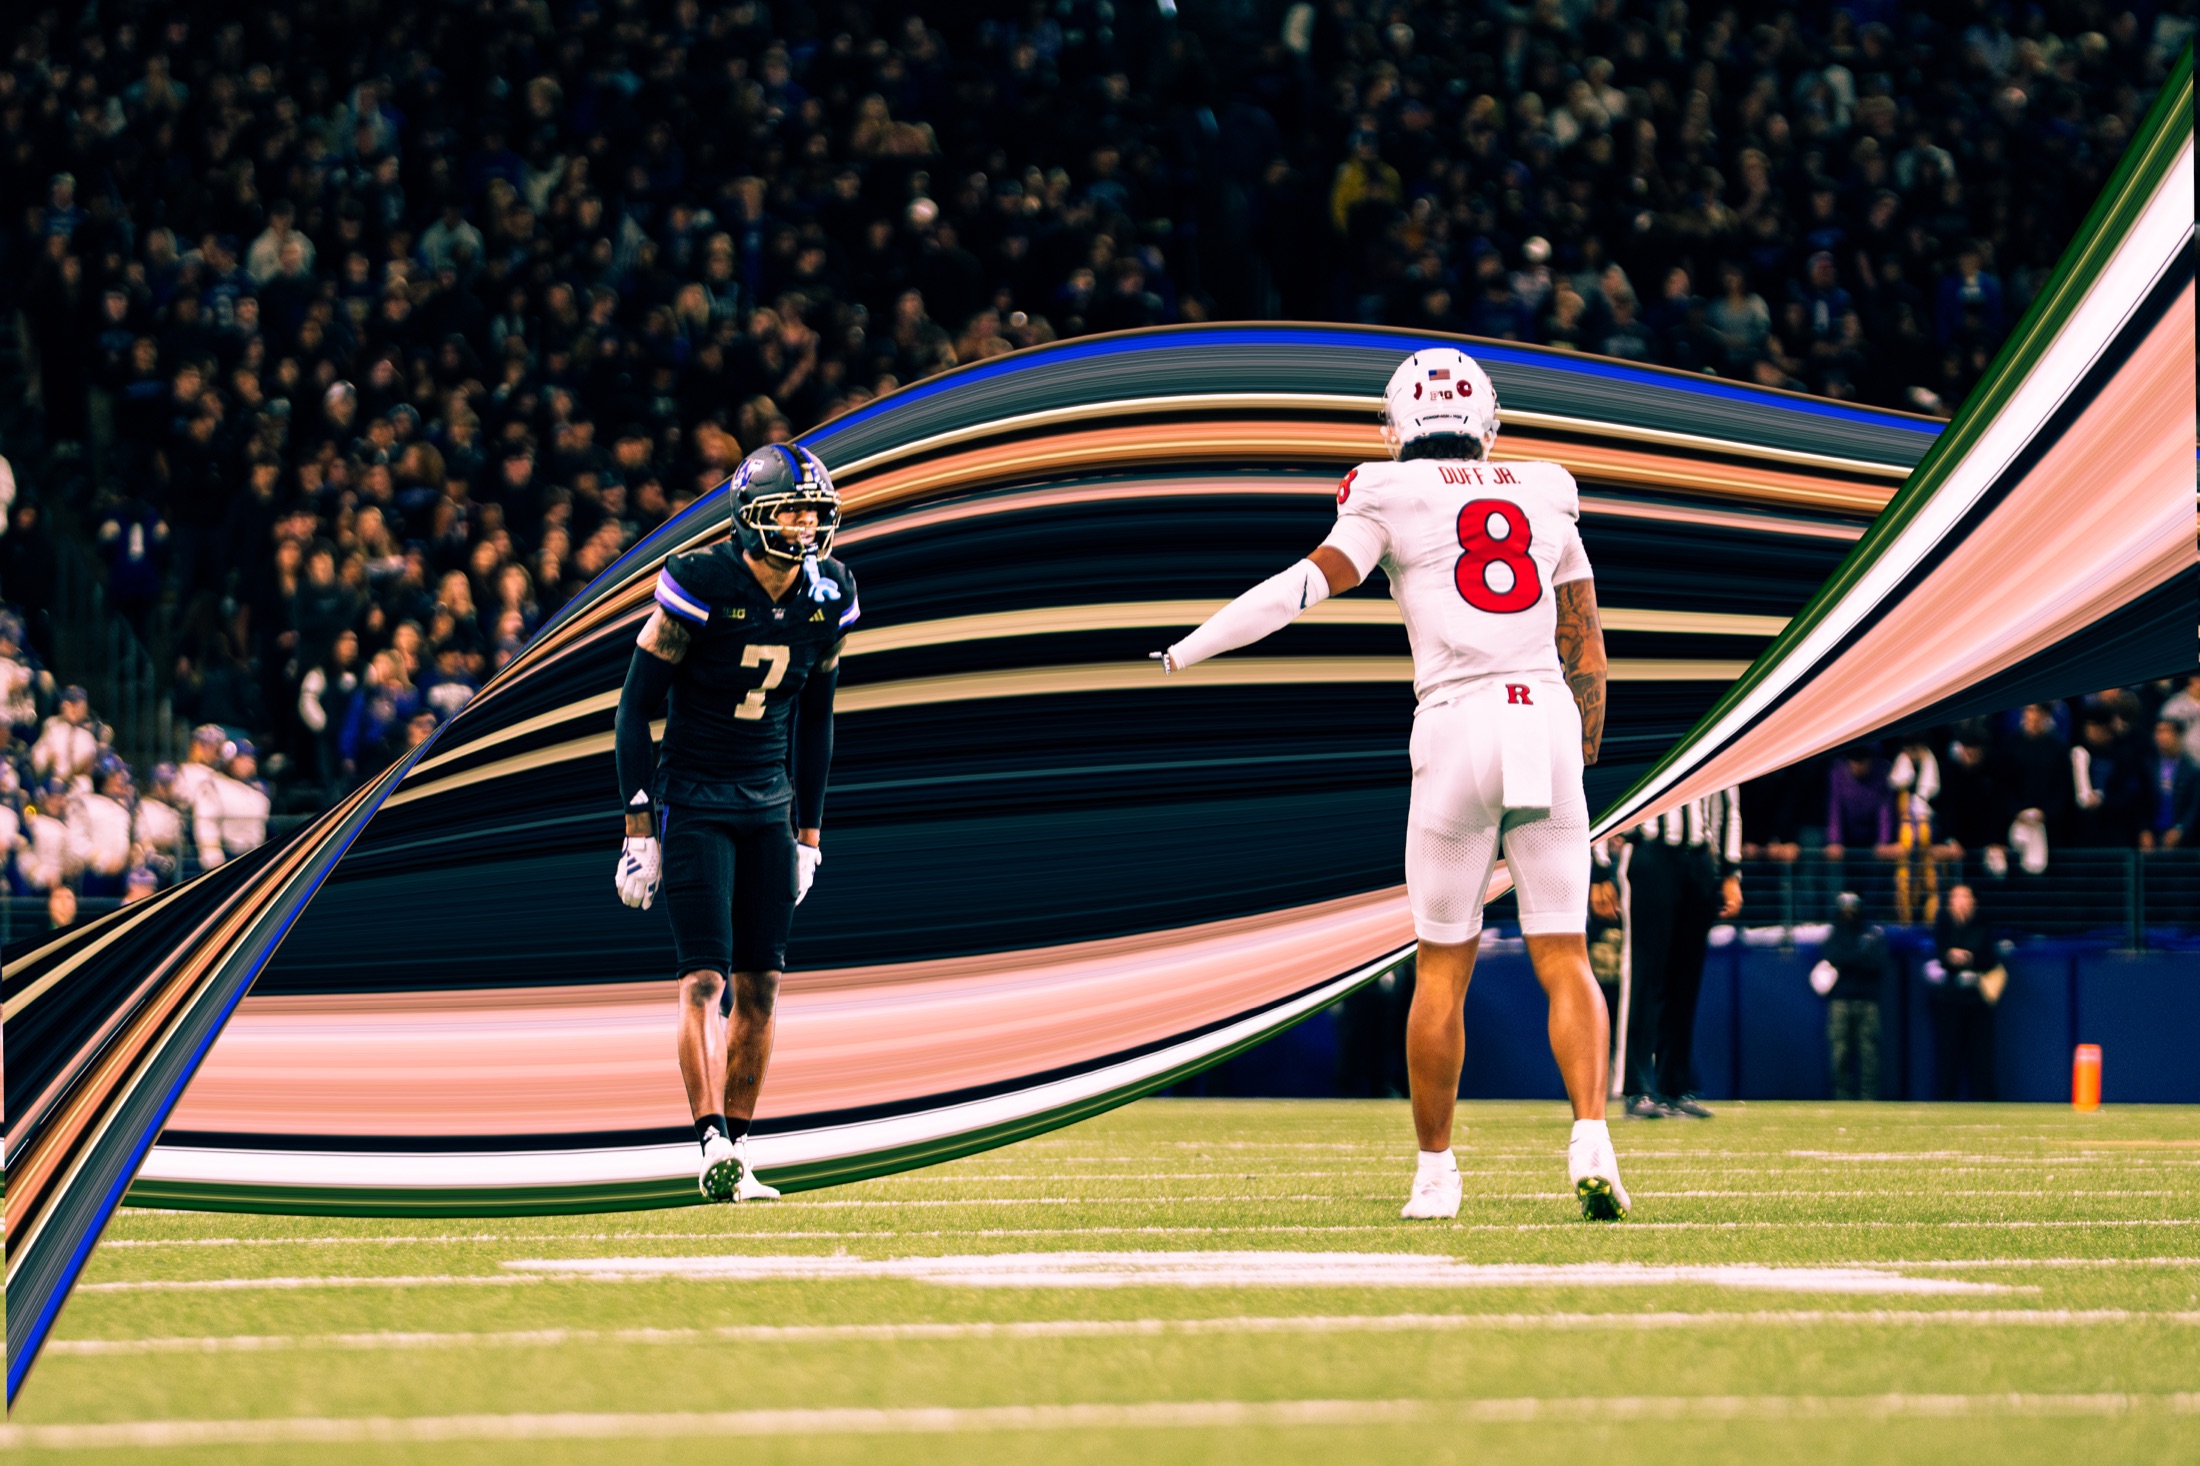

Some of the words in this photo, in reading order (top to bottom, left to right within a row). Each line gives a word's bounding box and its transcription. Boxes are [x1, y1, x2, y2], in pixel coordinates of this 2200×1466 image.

[1336, 469, 1359, 505] 8
[1438, 466, 1484, 486] DUFF
[1493, 467, 1522, 486] JR.
[1454, 498, 1543, 614] 8
[734, 643, 791, 721] 7
[1505, 683, 1534, 705] R
